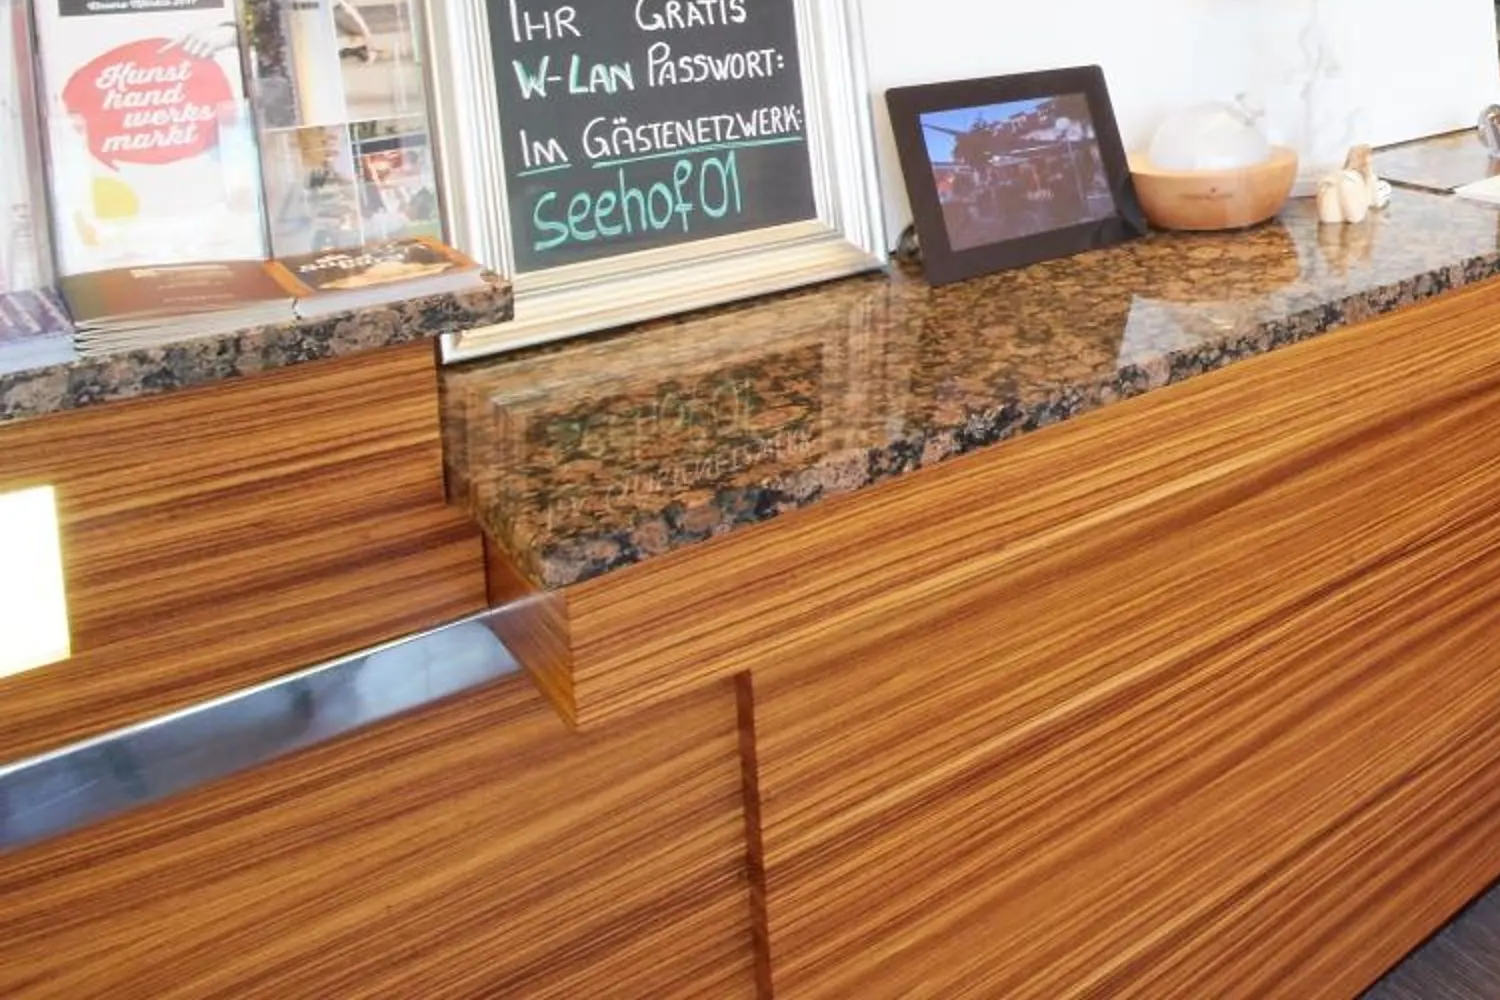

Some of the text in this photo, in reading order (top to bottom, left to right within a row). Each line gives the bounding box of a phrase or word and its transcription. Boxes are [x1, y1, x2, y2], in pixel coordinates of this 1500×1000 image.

[511, 53, 636, 100] W-LAN
[103, 83, 186, 110] hand
[122, 103, 217, 129] werks
[101, 124, 201, 153] markt
[520, 128, 569, 168] IM
